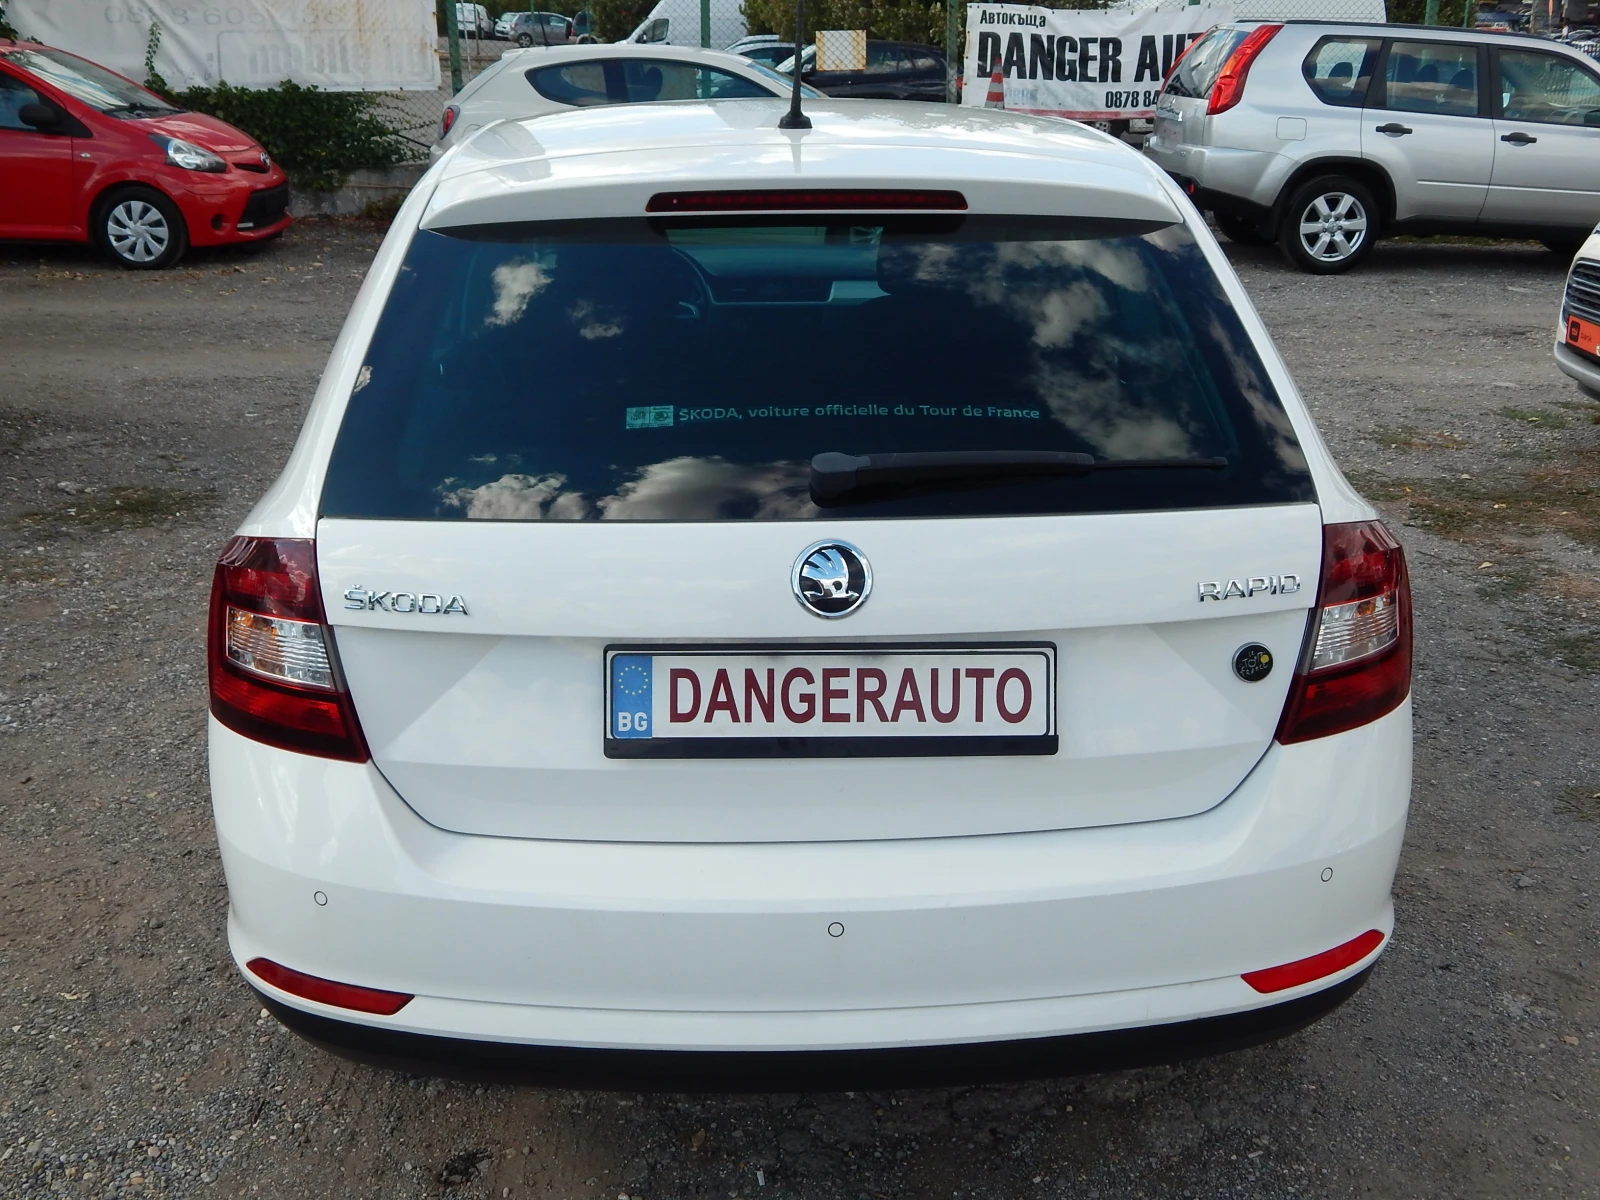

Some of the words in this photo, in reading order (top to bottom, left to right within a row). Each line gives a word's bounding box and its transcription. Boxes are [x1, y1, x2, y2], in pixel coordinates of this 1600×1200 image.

[979, 9, 1046, 28] Автокъща
[977, 31, 1122, 84] DANGER
[1105, 90, 1139, 108] 0878
[679, 407, 743, 421] ŠKODA,
[748, 406, 809, 418] voiture
[815, 404, 889, 416] officielle
[893, 404, 915, 416] du
[919, 405, 957, 416] Tour
[963, 405, 983, 417] de
[988, 406, 1040, 419] France
[343, 584, 469, 615] ŠKODA
[1198, 573, 1301, 602] RAPID
[668, 667, 1032, 724] DANGERAUTO
[618, 711, 648, 732] BG
